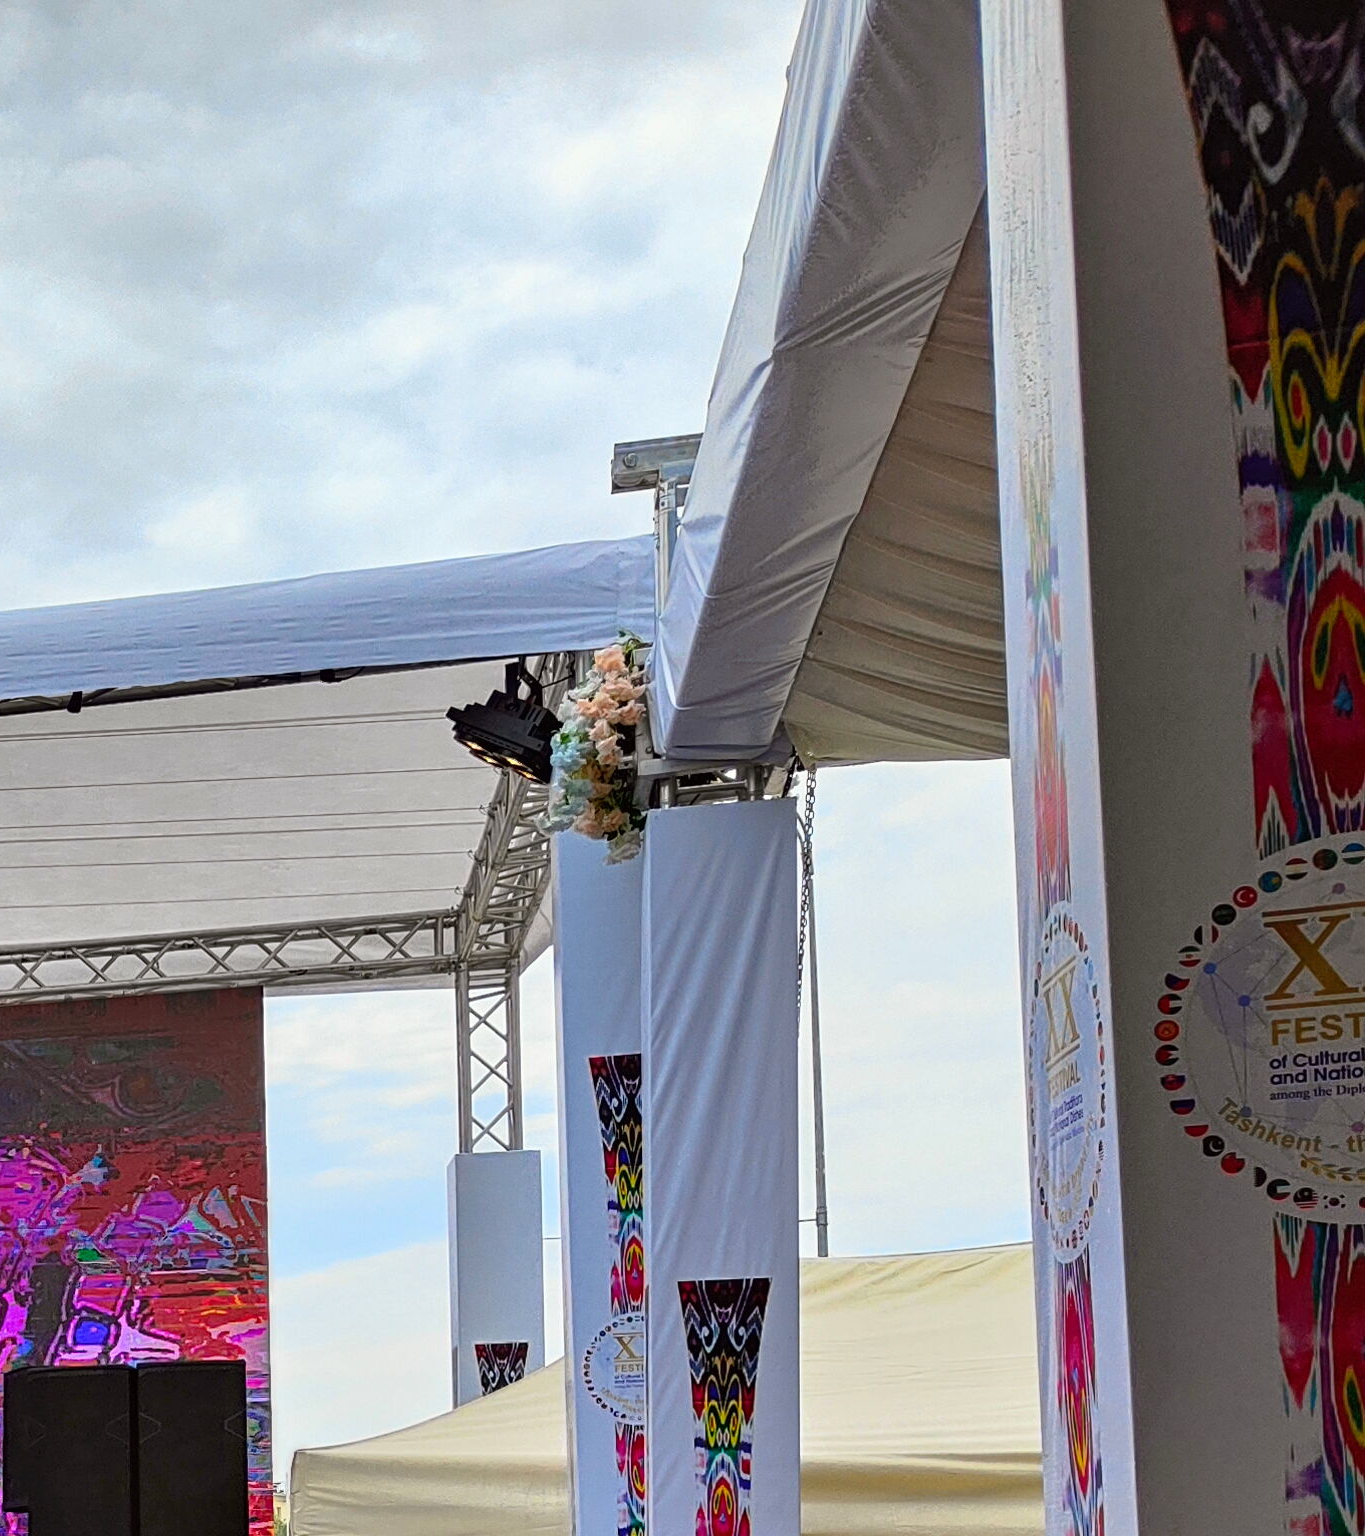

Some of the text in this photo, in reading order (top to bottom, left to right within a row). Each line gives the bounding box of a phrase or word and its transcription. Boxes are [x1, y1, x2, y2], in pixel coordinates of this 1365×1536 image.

[1264, 912, 1365, 1000] X
[1044, 966, 1080, 1062] XX
[1271, 1013, 1365, 1046] FEST
[1270, 1047, 1365, 1070] of Cultural
[1270, 1065, 1365, 1085] and Natio
[1270, 1090, 1310, 1101] among
[1313, 1085, 1332, 1097] the
[1218, 1097, 1322, 1152] Tashkent
[613, 1335, 644, 1360] X
